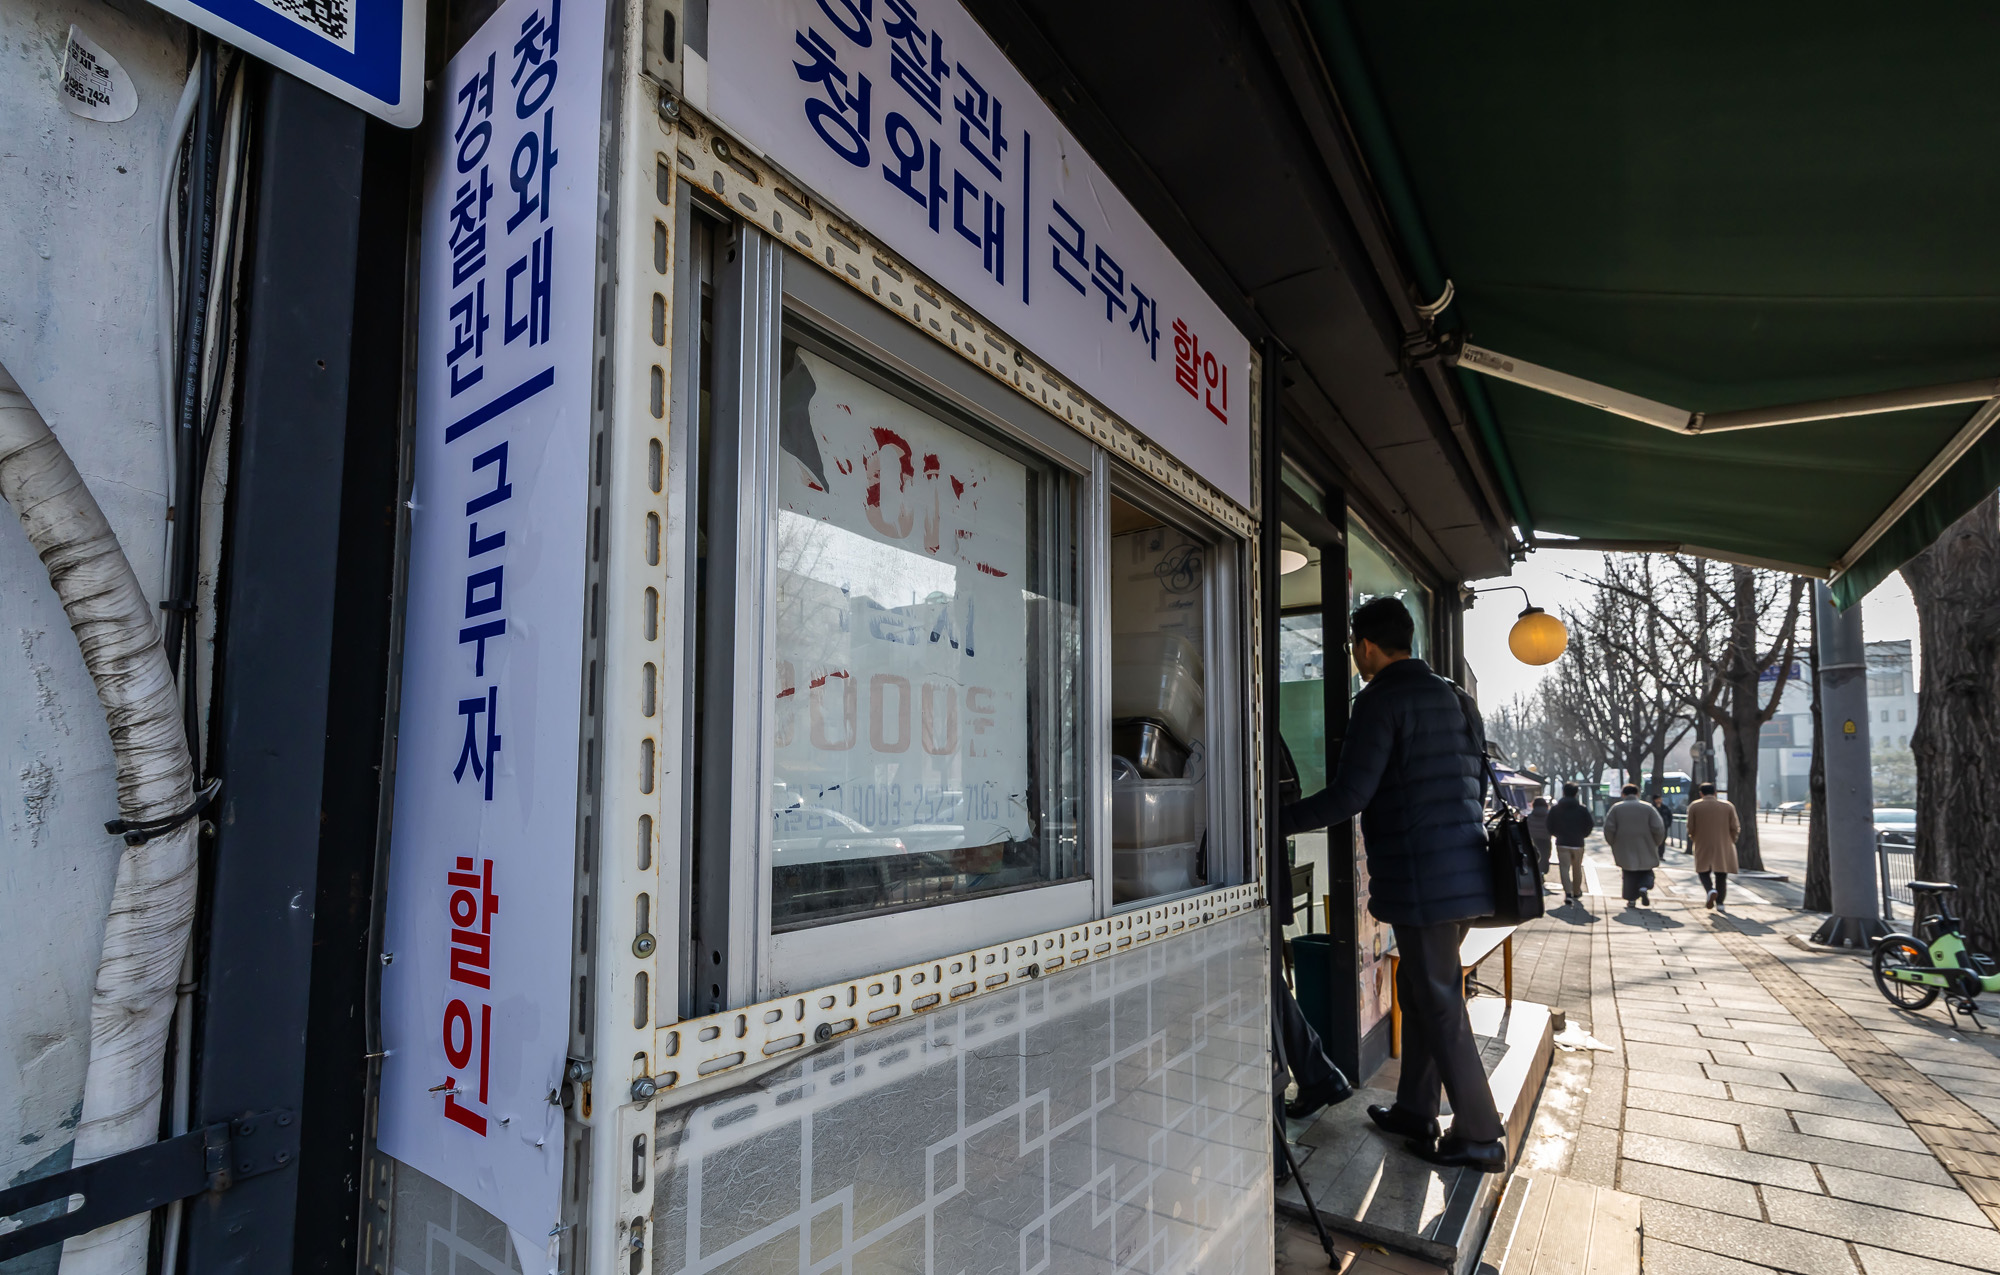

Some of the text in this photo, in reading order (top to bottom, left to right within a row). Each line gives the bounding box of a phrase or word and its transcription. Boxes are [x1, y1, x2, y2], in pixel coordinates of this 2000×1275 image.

[446, 51, 497, 399] 경찰관
[504, 0, 562, 349] 청와대
[793, 27, 1005, 286] 청와대
[1048, 199, 1228, 425] 근무자 할인
[443, 440, 513, 1138] 근무자 할인
